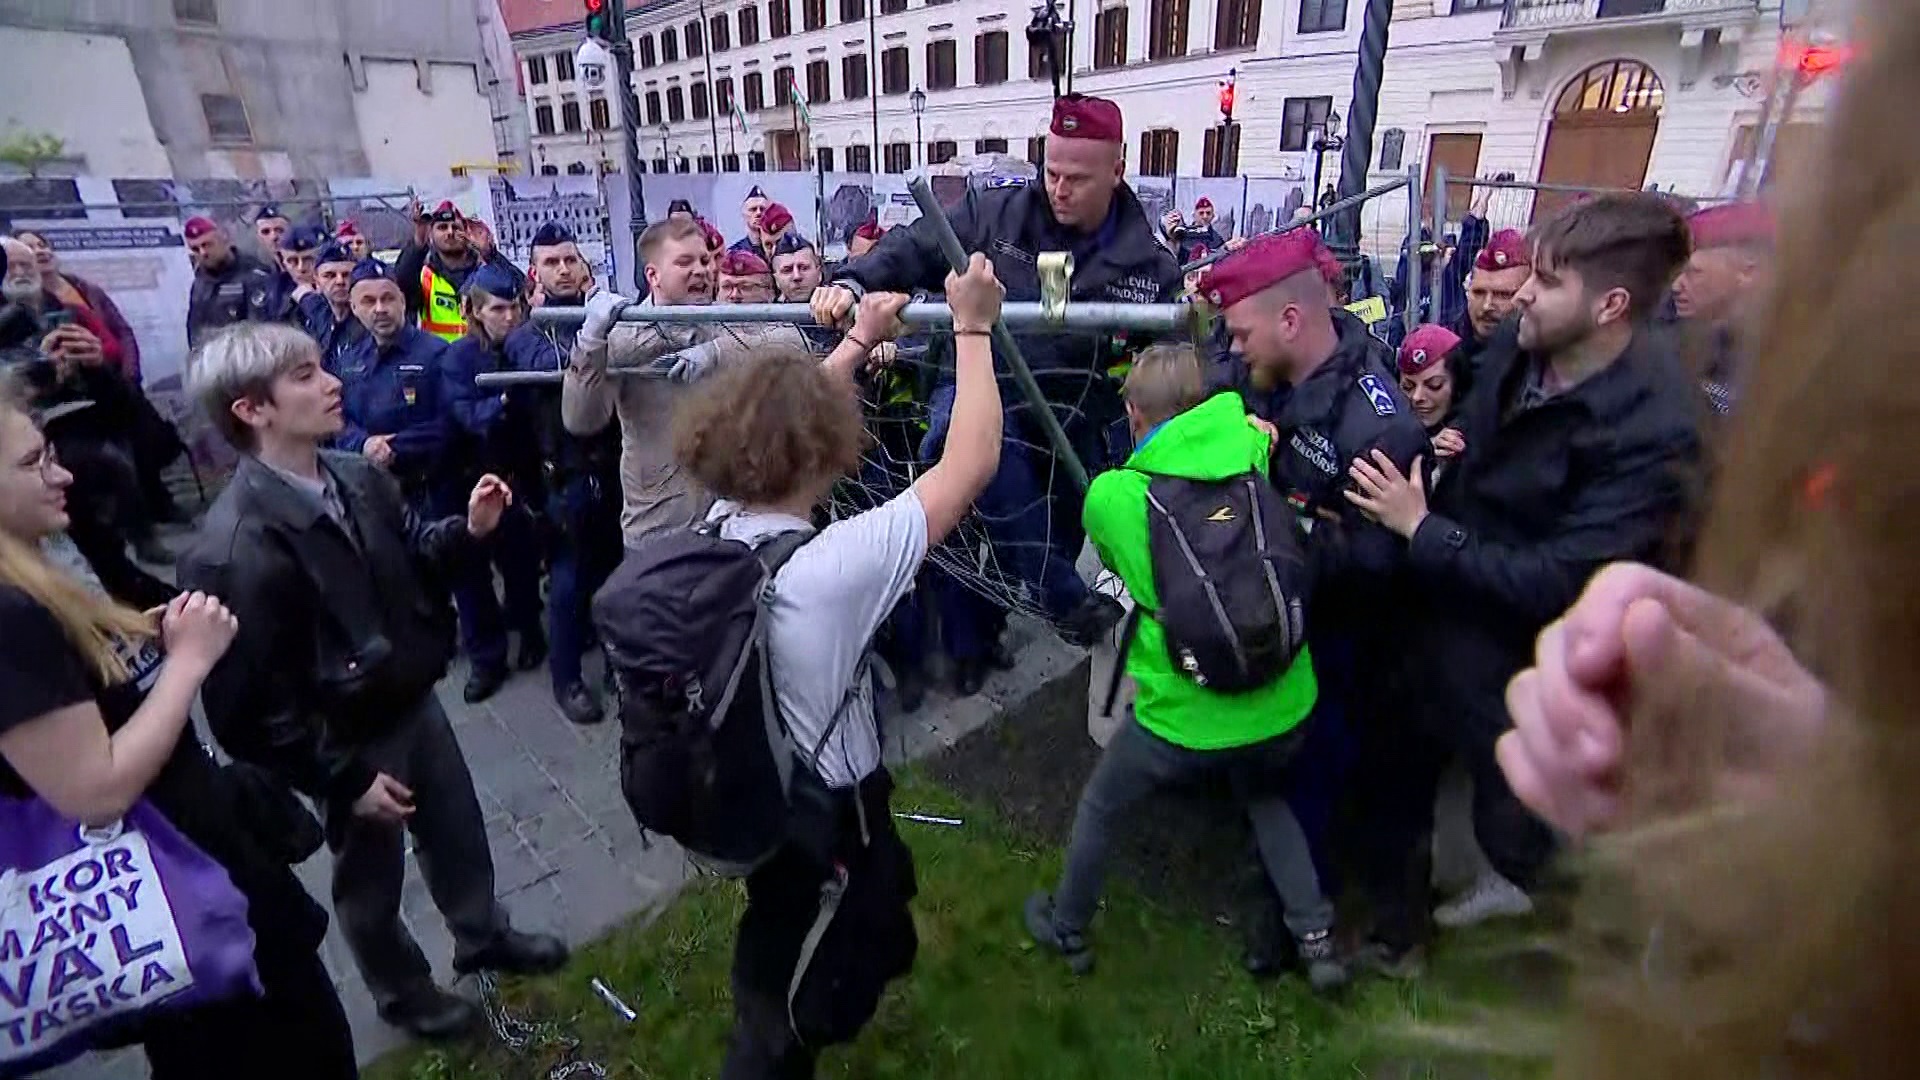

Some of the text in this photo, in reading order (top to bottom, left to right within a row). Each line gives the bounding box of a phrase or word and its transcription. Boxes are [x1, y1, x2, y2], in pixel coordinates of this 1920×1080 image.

[29, 849, 138, 913] KOR
[0, 924, 163, 1009] VÁL
[0, 961, 174, 1046] TÁSKA
